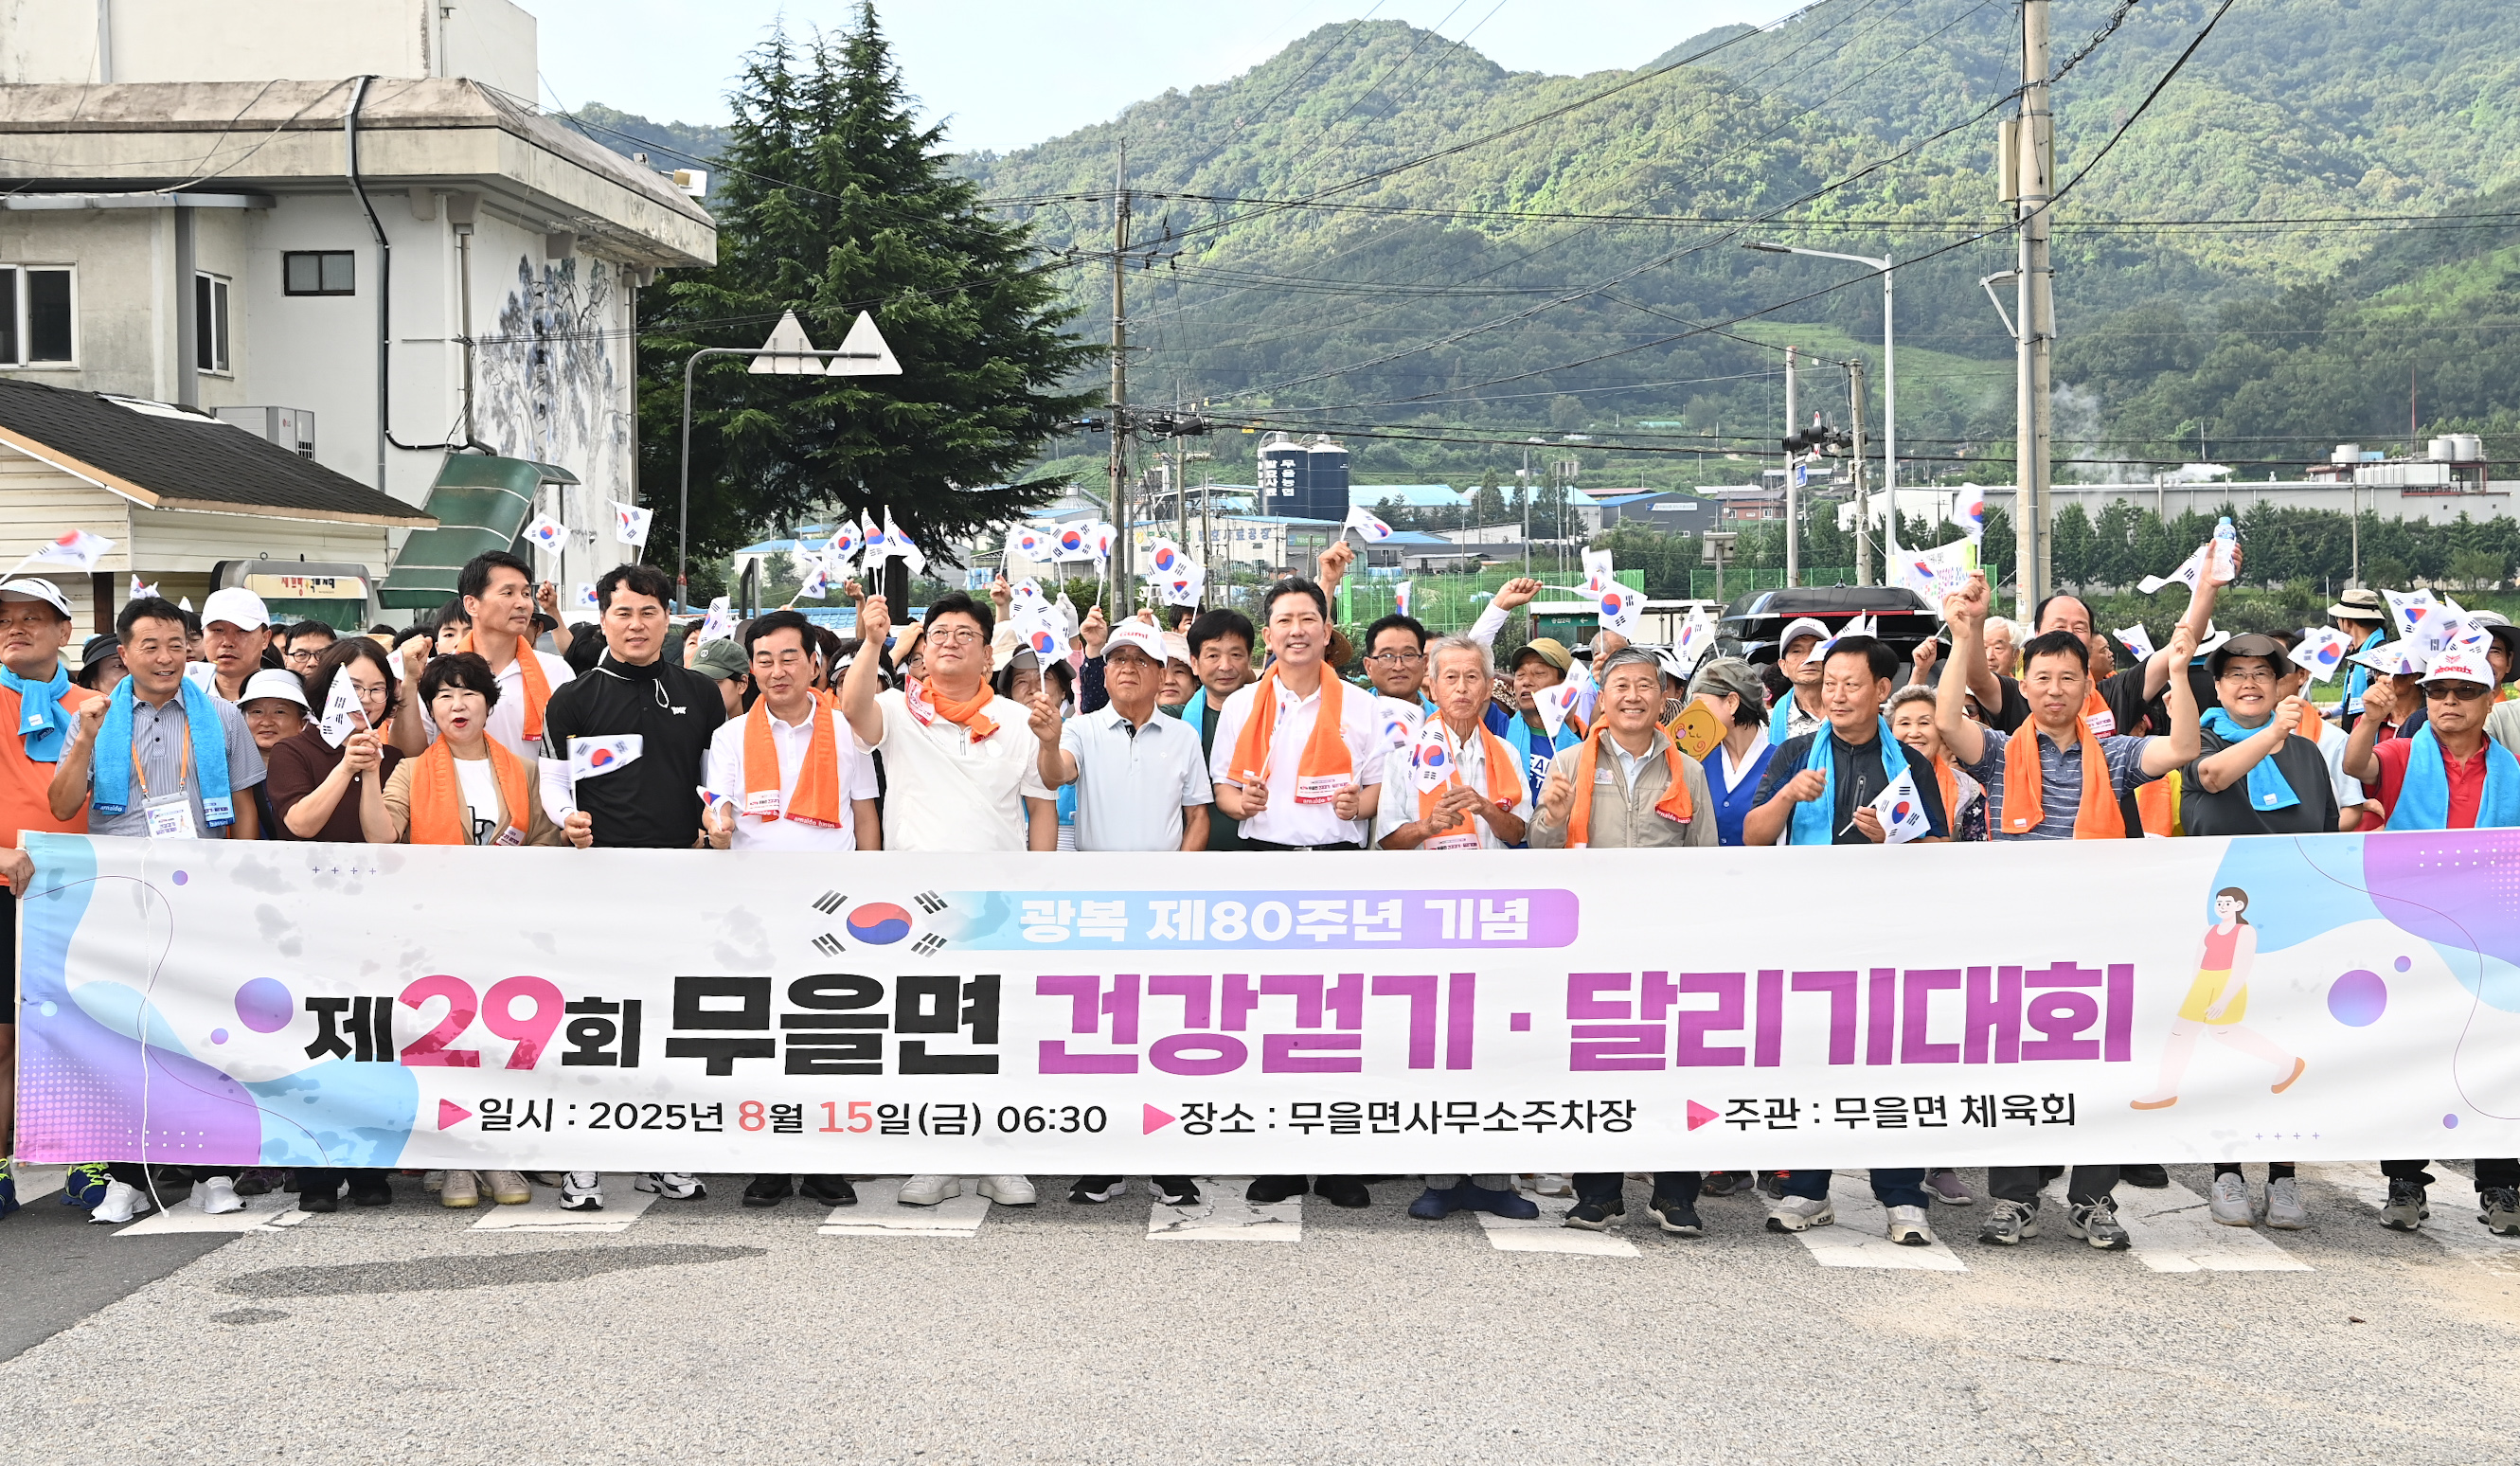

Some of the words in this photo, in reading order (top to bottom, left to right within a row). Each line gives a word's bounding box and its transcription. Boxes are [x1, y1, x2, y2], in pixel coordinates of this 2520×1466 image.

[1279, 458, 1296, 497] 무을농협
[1020, 900, 1129, 943] 광복
[1145, 899, 1403, 942] 제80주년
[1424, 898, 1529, 940] 기념
[304, 974, 642, 1071] 제29회
[665, 973, 1002, 1077] 무을면
[1036, 973, 1476, 1076] 건강걷기
[1566, 961, 2135, 1072] 달리기대회
[479, 1098, 554, 1133] 일시
[588, 1101, 724, 1133] 2025년
[739, 1100, 804, 1135] 8월
[818, 1100, 981, 1137] 15일(금)
[997, 1105, 1107, 1134] 06:30
[1179, 1101, 1256, 1135] 장소
[1288, 1099, 1636, 1135] 무을면사무소주차장
[1725, 1097, 1801, 1132] 주관
[1833, 1095, 1948, 1130] 무을면
[1960, 1093, 2075, 1128] 체육회
